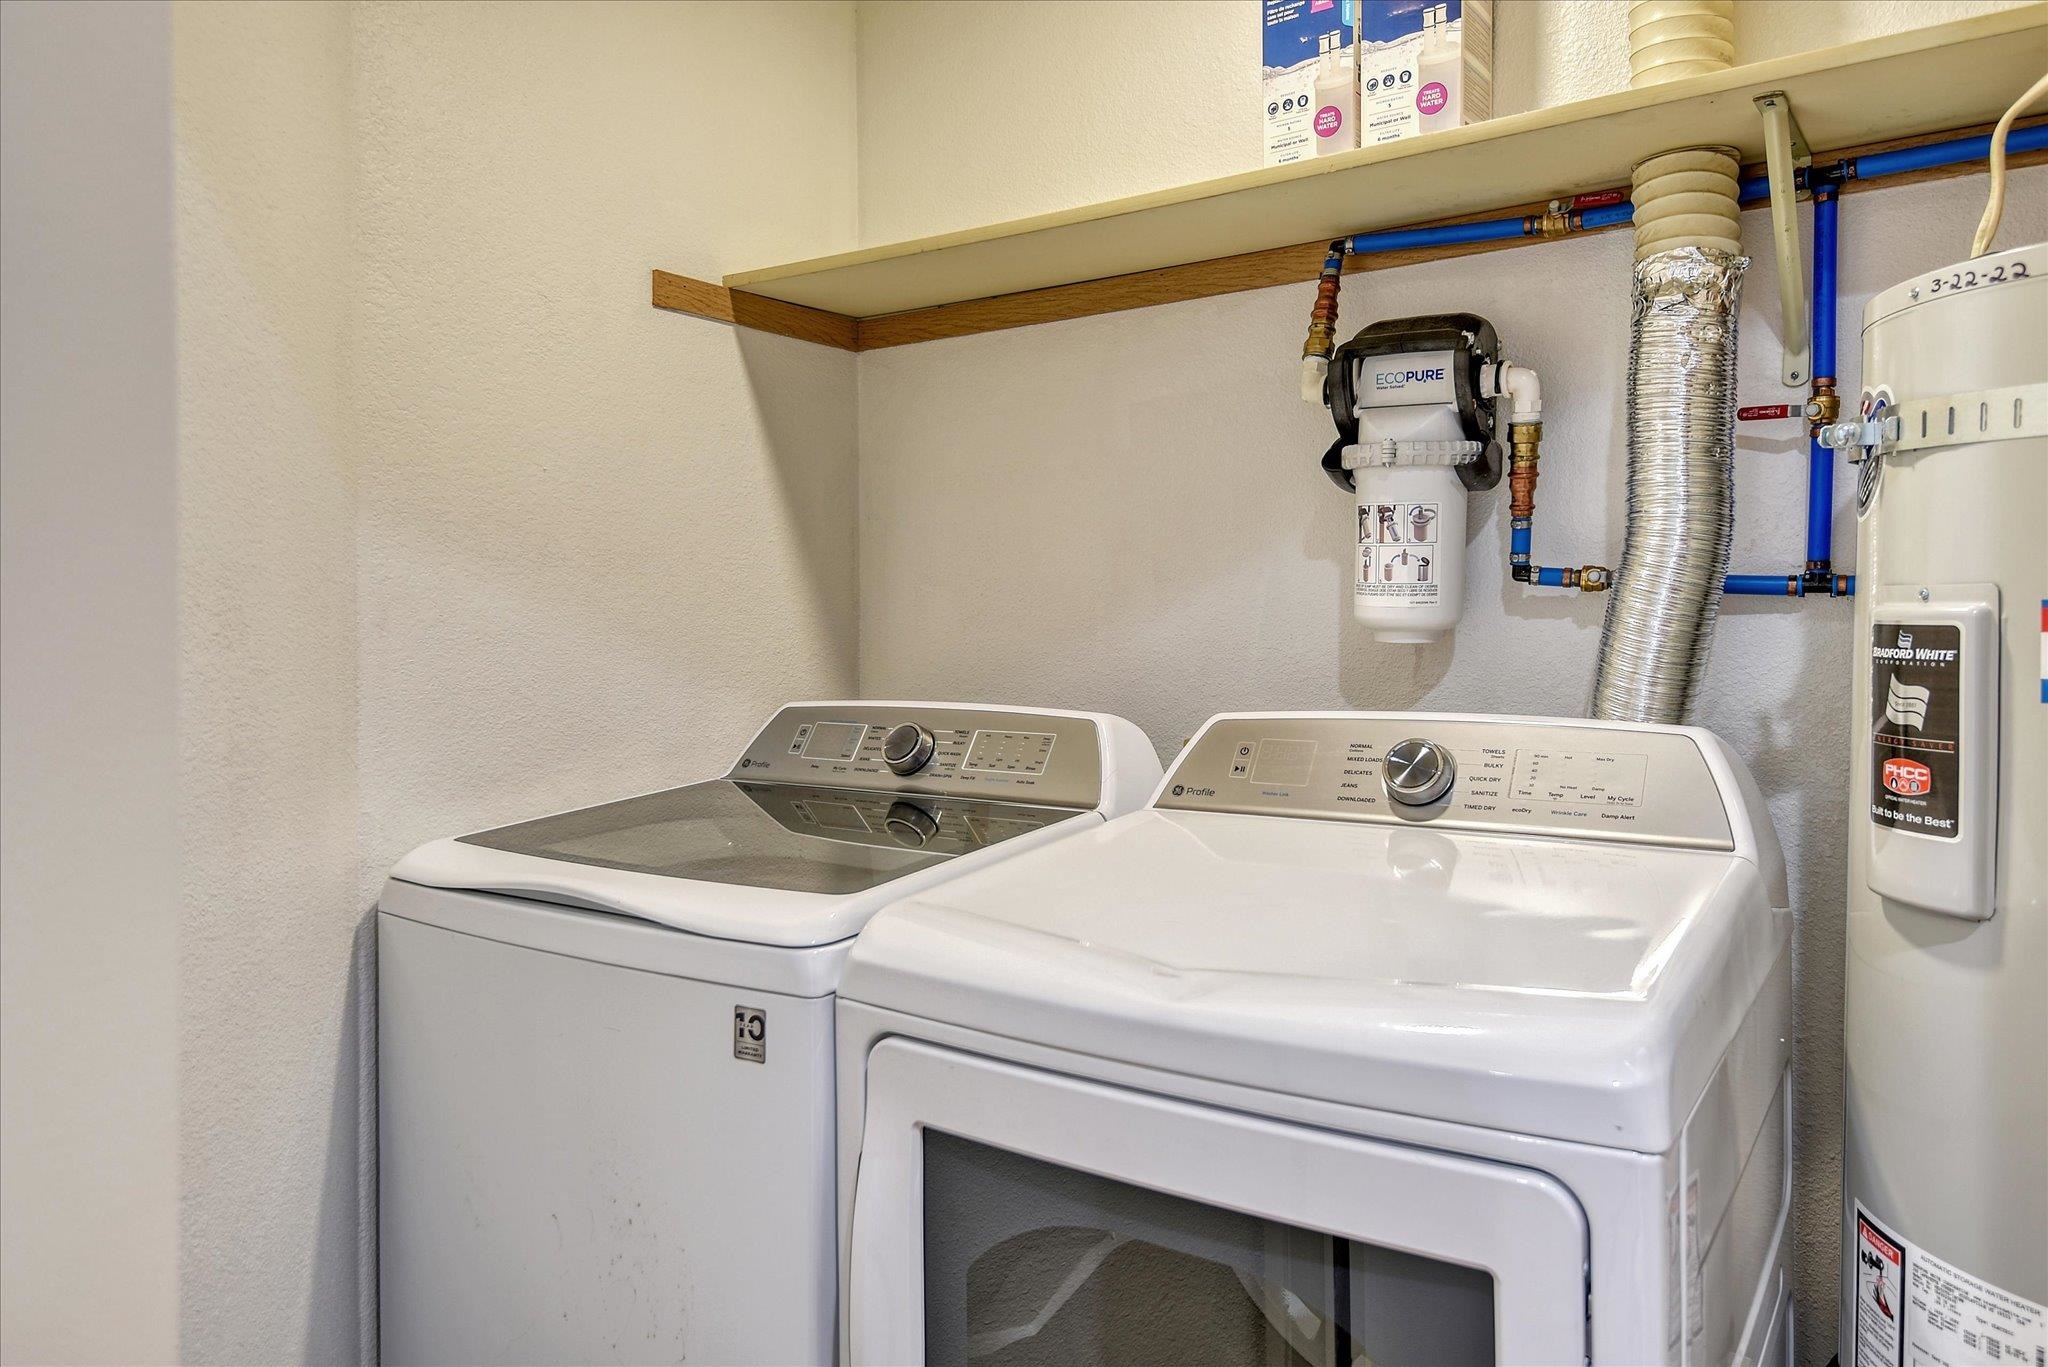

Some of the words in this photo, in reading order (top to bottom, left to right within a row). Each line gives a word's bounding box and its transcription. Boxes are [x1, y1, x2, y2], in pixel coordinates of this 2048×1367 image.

[1422, 92, 1441, 101] HARD
[1420, 98, 1443, 108] WATER
[1317, 122, 1338, 130] WATER
[1319, 116, 1336, 124] HARD
[1370, 118, 1392, 128] Municipal
[1270, 141, 1292, 150] Municipal
[1931, 262, 2030, 293] 3-22-22
[1376, 368, 1445, 385] ECOPURE
[1872, 646, 1914, 658] BRADFORD
[1915, 648, 1956, 660] WHITE
[1912, 740, 1954, 750] SAVER
[1886, 764, 1928, 780] PHCC
[1186, 787, 1216, 796] Profile
[1872, 804, 1884, 816] Built
[1884, 809, 1892, 818] to
[1893, 810, 1904, 820] be
[1906, 814, 1922, 824] the
[1924, 816, 1952, 828] Best
[736, 1012, 766, 1041] 10
[1867, 1232, 1894, 1260] DANGER
[1921, 1255, 1951, 1276] AUTOMATIC
[1953, 1272, 1983, 1291] STORAGE
[1984, 1288, 2009, 1303] WATER
[2010, 1300, 2040, 1316] HEATER
